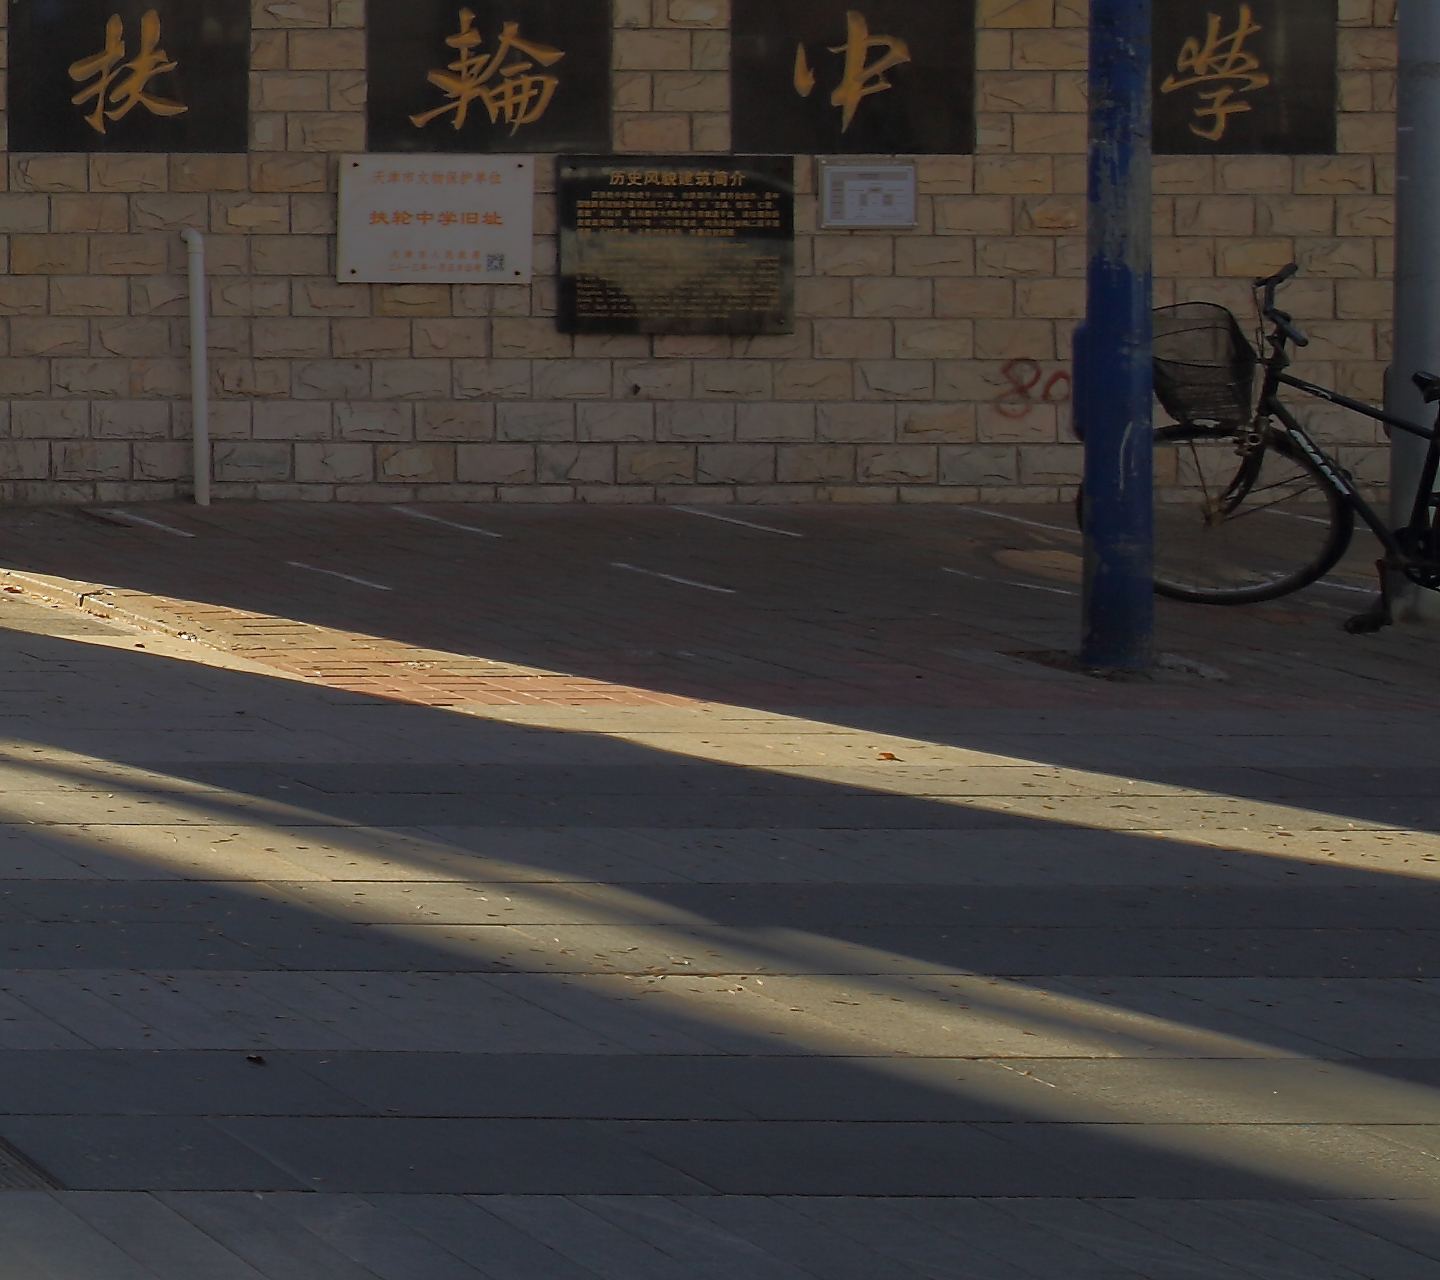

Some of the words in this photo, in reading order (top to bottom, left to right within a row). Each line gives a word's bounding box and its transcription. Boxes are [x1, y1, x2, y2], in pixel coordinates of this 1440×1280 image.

[68, 8, 188, 133] 扶
[793, 10, 911, 133] 中
[373, 171, 502, 185] 天津市文物保护单位
[609, 171, 745, 186] 历史风貌建筑简介
[369, 211, 505, 225] 扶轮中学旧址
